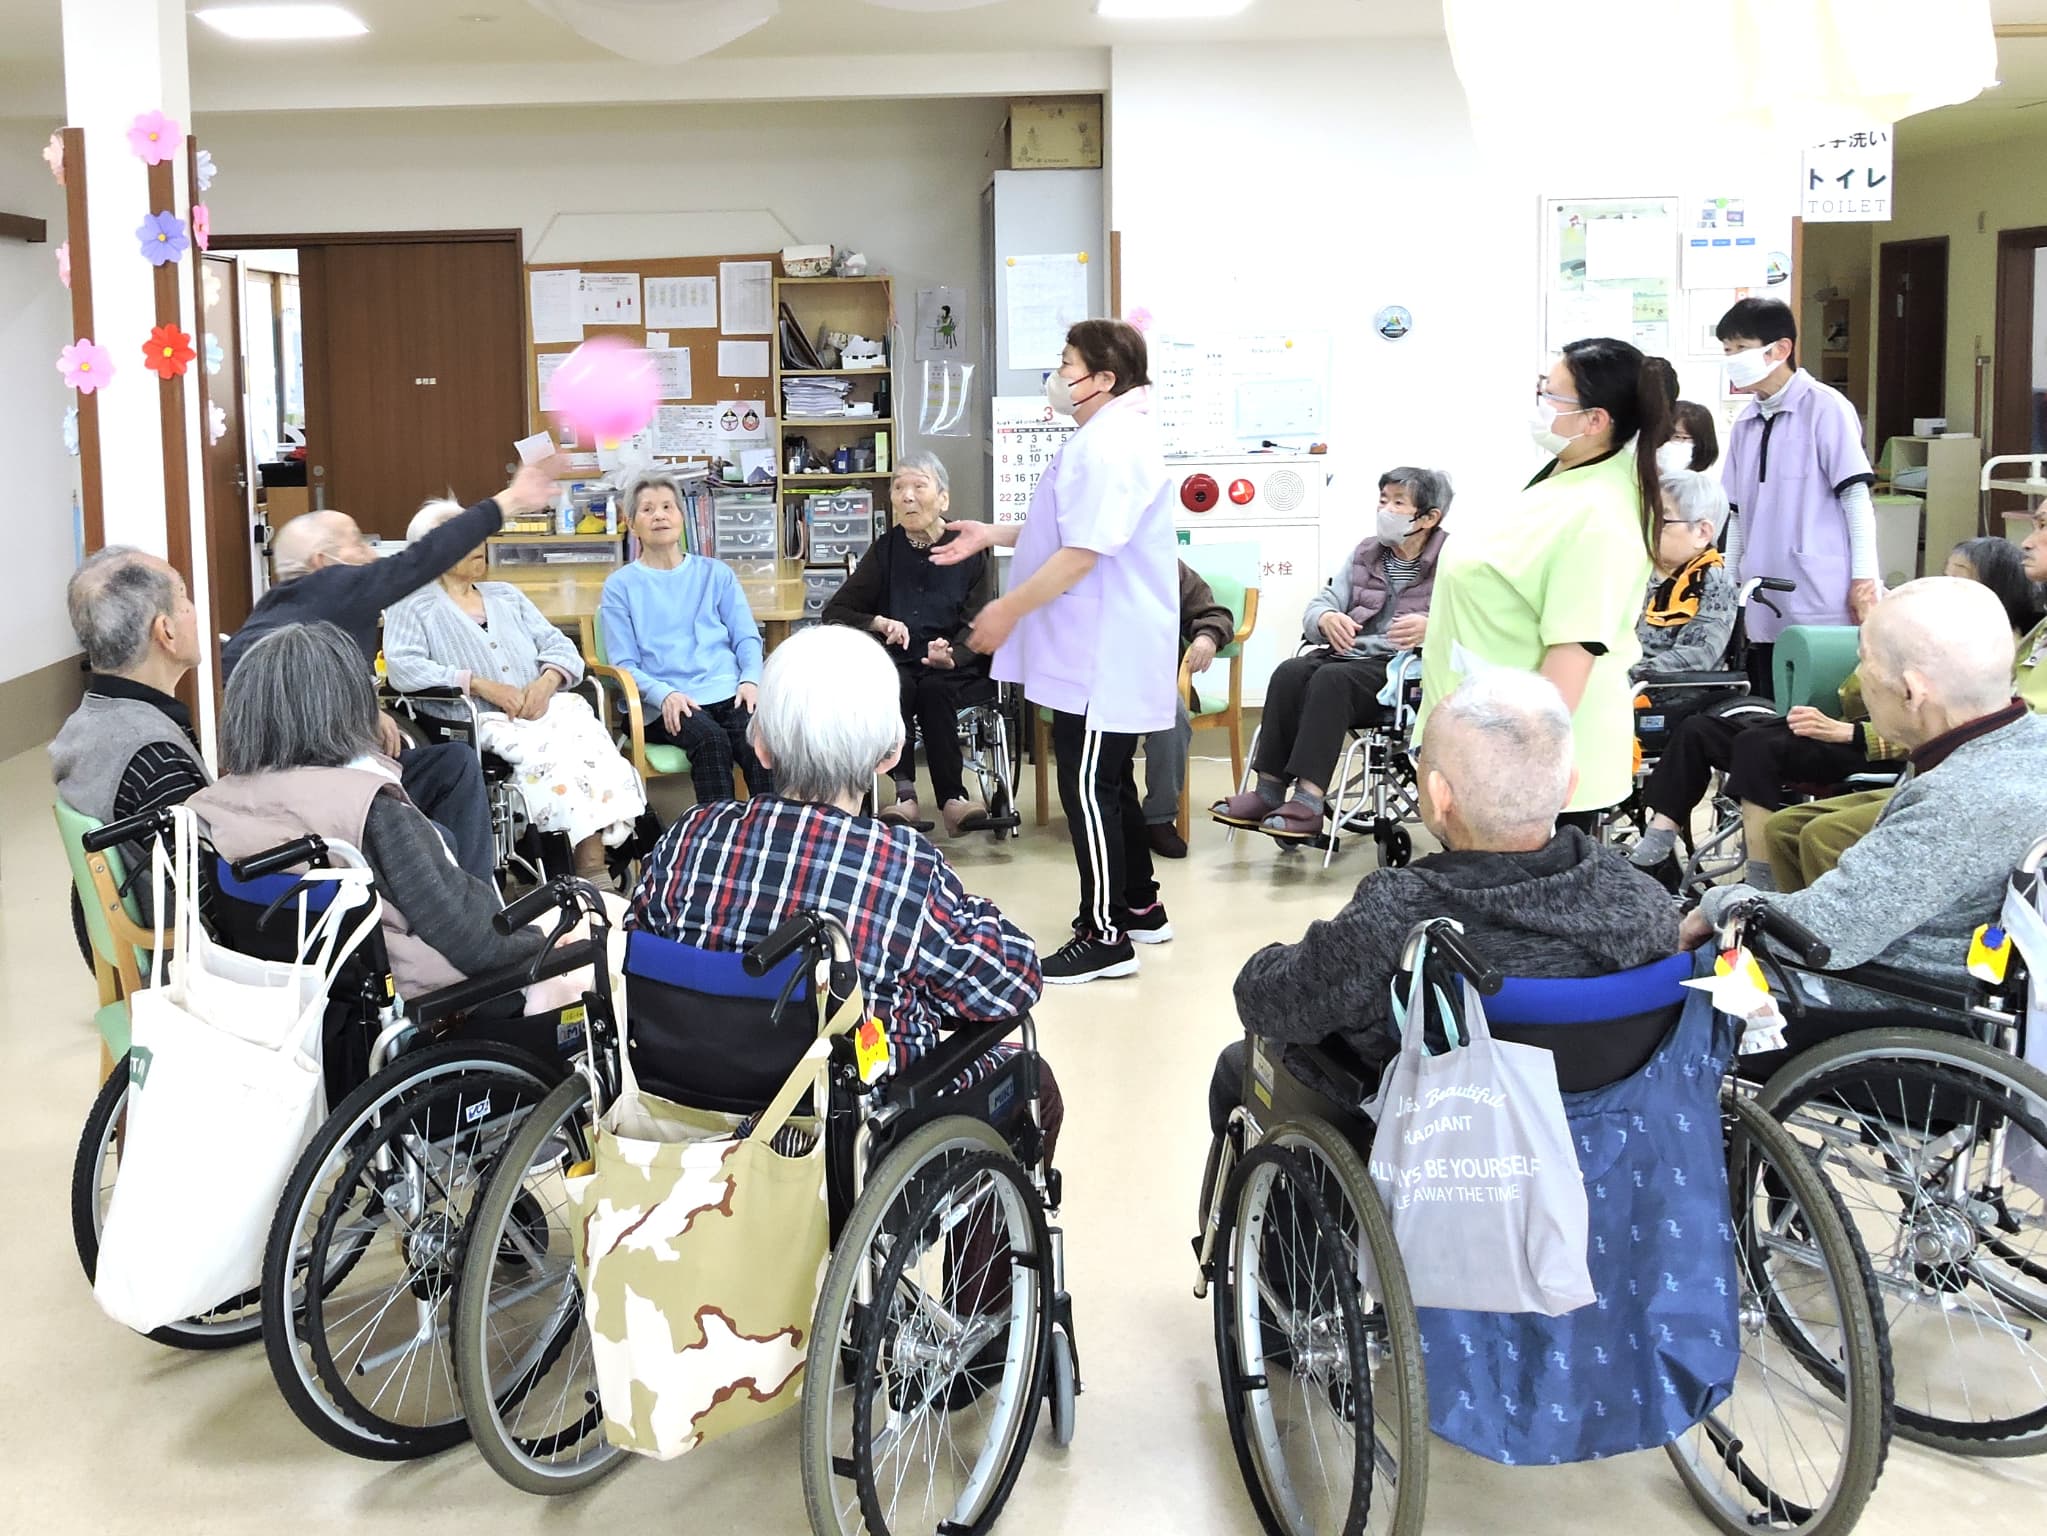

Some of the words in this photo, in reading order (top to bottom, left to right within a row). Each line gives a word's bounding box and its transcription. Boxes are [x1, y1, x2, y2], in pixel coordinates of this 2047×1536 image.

[1812, 131, 1887, 149] 手洗い
[1809, 168, 1887, 190] トイレ
[1808, 200, 1886, 213] TOILET
[1043, 406, 1054, 422] 3
[1016, 434, 1023, 443] 2
[1031, 434, 1038, 443] 3
[1046, 434, 1052, 442] 4
[1061, 433, 1067, 442] 5
[1002, 454, 1008, 463] 8
[1016, 454, 1023, 463] 9
[1029, 453, 1041, 462] 10
[1000, 474, 1011, 482] 15
[1015, 473, 1026, 482] 16
[1029, 473, 1040, 481] 17
[1000, 493, 1012, 502] 22
[1014, 492, 1026, 502] 23
[1000, 512, 1012, 521] 29
[1014, 511, 1027, 521] 30
[1263, 561, 1293, 576] 水栓
[1425, 1083, 1507, 1109] Beautiful
[1404, 1115, 1473, 1145] RADIANT
[1424, 1158, 1449, 1179] BE
[1450, 1155, 1542, 1179] YOURSELF
[1413, 1186, 1453, 1203] AWAY
[1455, 1186, 1485, 1203] THE
[1487, 1184, 1521, 1202] TIME
